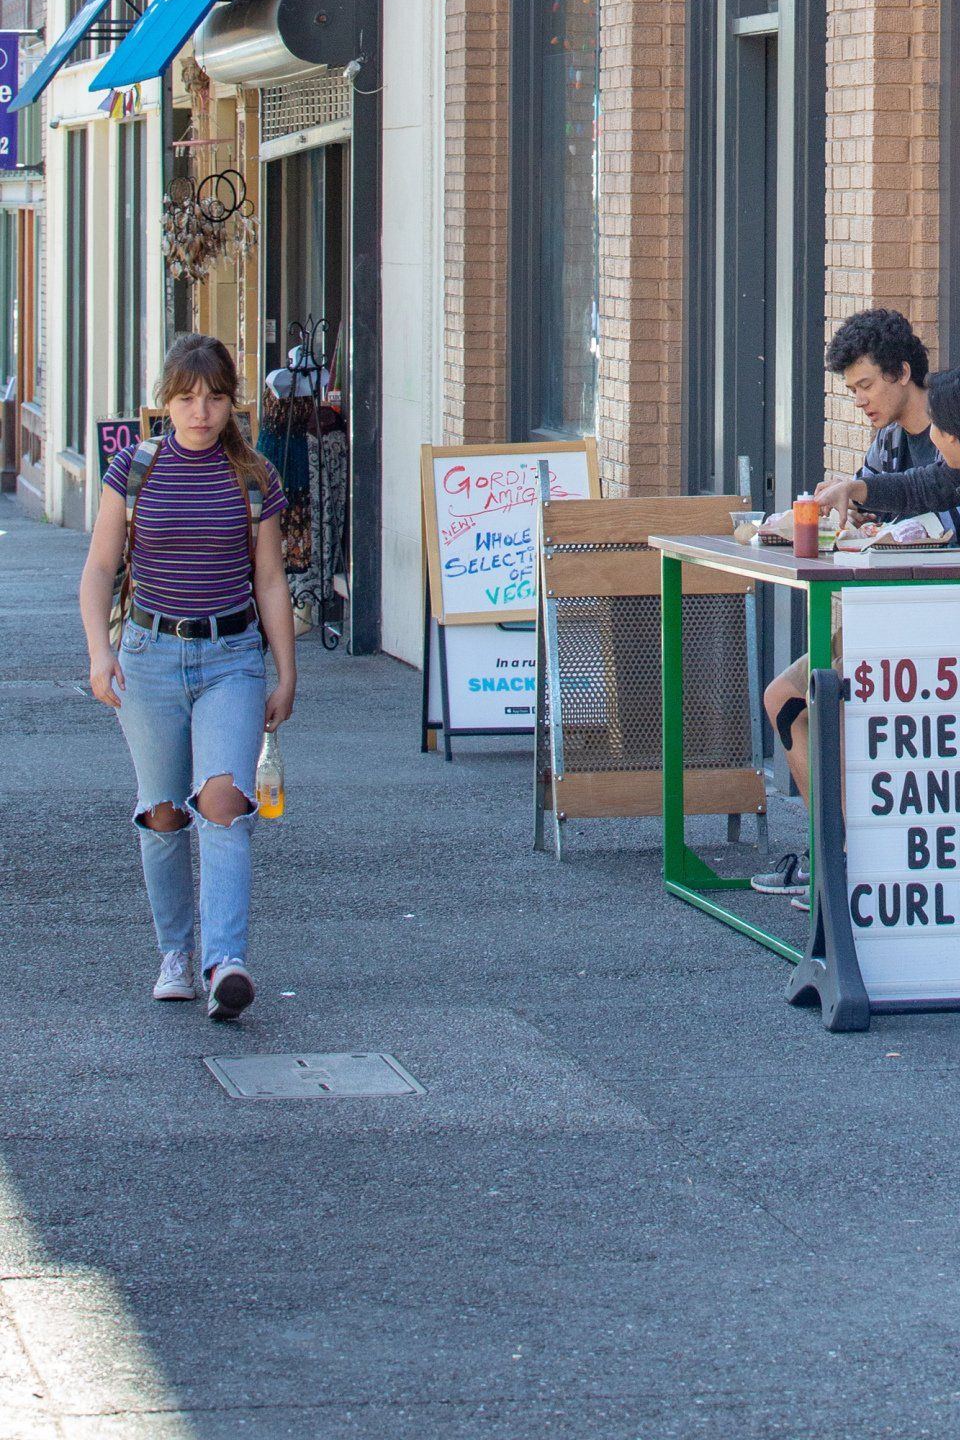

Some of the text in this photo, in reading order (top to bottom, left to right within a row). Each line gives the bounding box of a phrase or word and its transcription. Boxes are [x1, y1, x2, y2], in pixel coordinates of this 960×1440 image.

[475, 528, 531, 551] WHOLE
[445, 546, 537, 578] SELECTI
[485, 579, 536, 605] VEG
[468, 677, 536, 692] SNACK
[854, 656, 958, 703] $10.5
